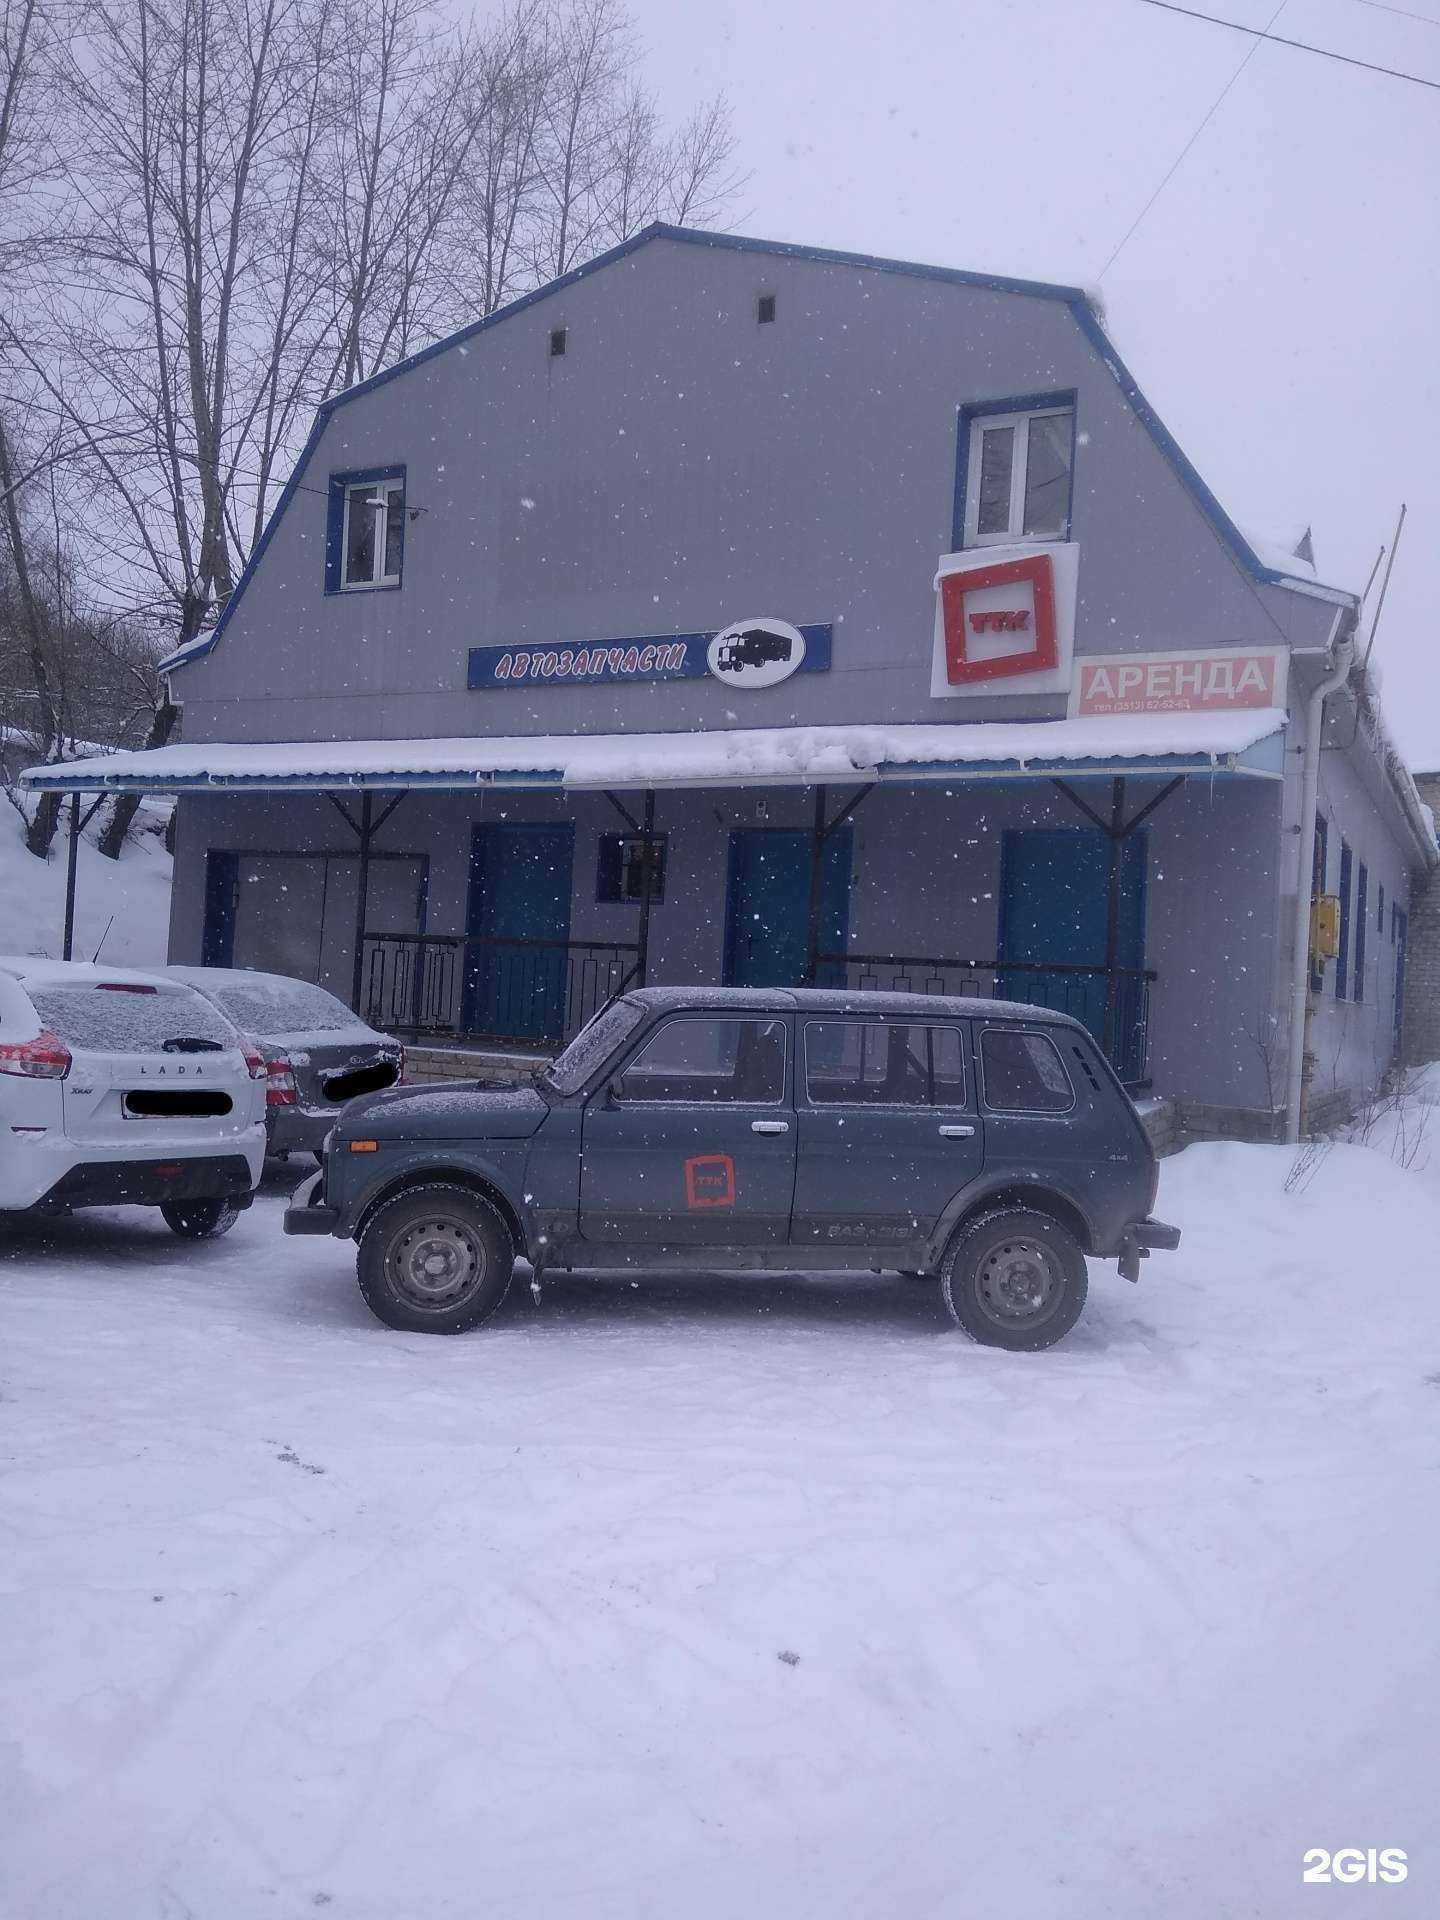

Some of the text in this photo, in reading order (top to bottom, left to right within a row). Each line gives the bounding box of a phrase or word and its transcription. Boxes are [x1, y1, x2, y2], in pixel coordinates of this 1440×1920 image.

[969, 610, 1031, 634] ТТК
[495, 643, 687, 679] АВТОЗАПЧАСТИ
[1085, 659, 1268, 700] АРЕНДА
[140, 1065, 203, 1075] LADA
